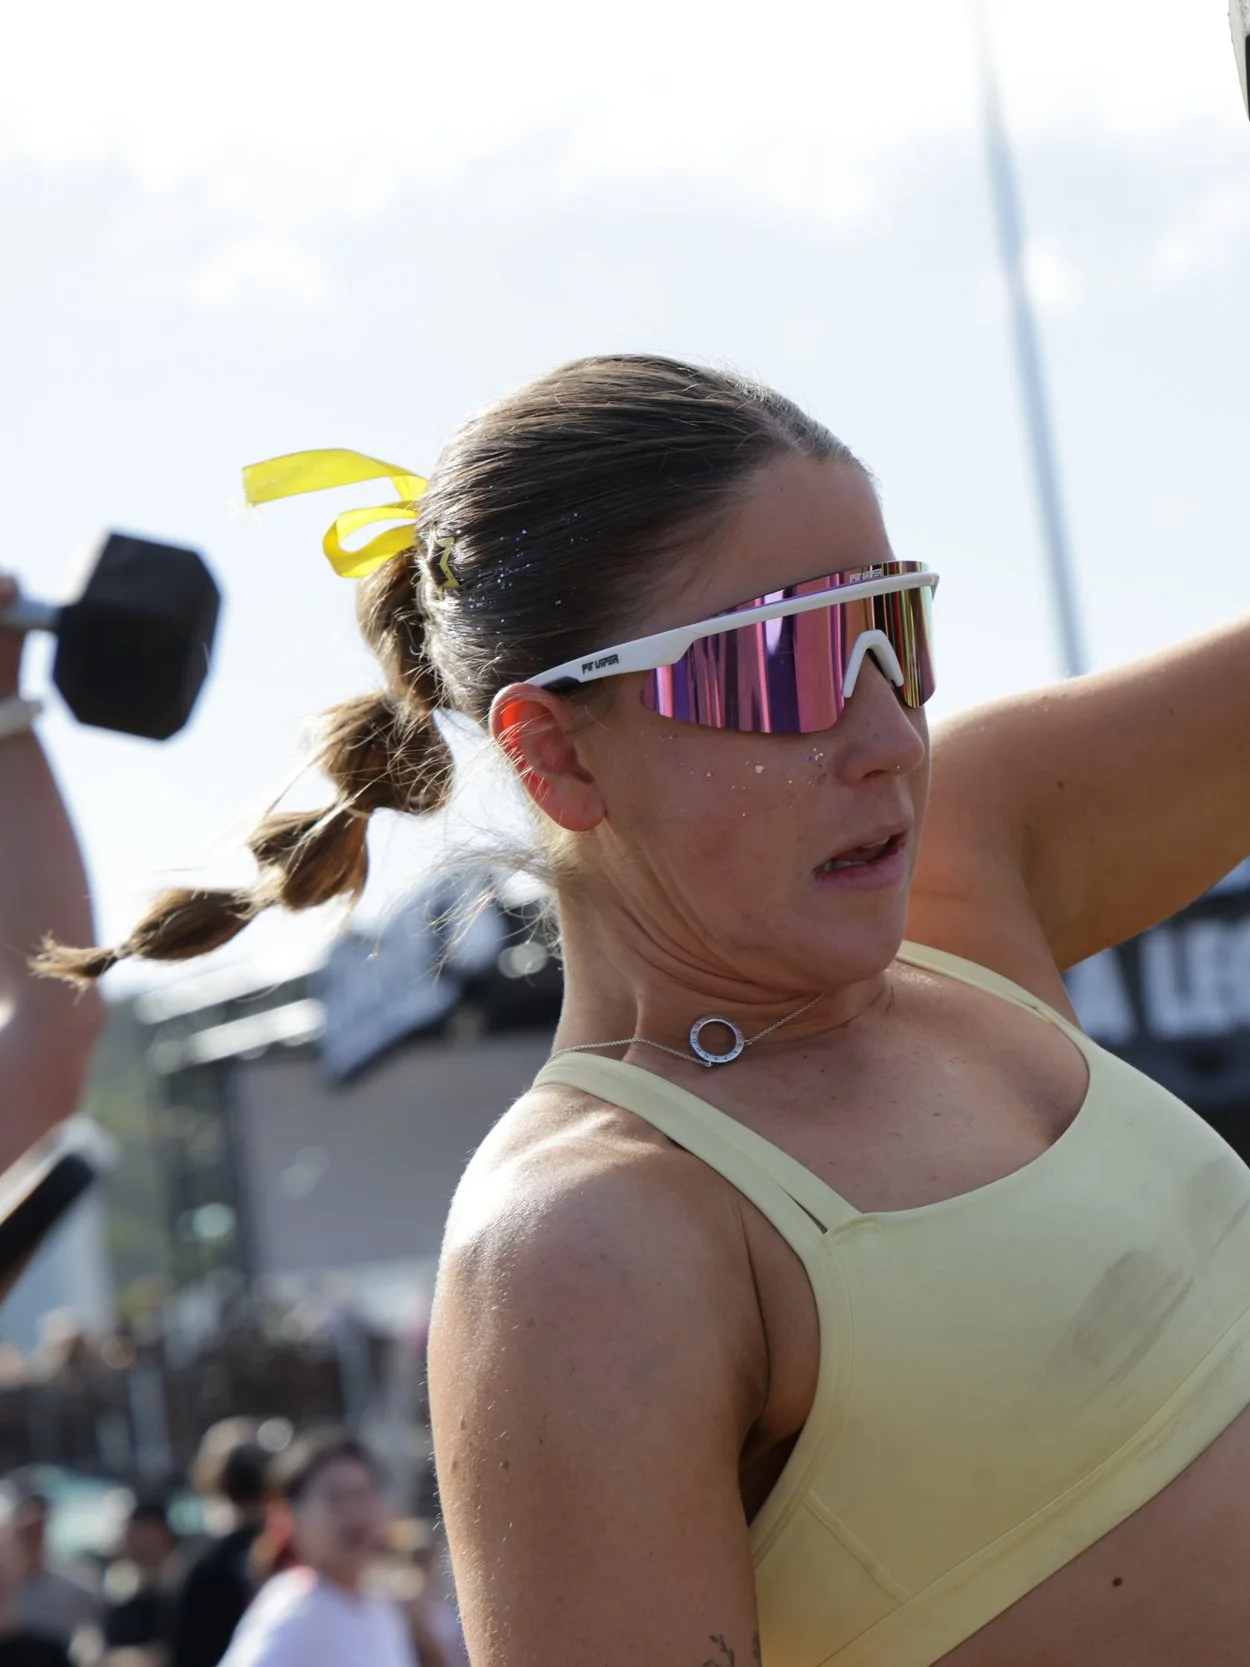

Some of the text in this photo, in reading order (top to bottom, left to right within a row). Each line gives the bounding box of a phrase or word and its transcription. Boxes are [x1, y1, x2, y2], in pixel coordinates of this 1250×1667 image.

[850, 569, 882, 583] PIT VIPER
[583, 654, 619, 674] PIT VIPER
